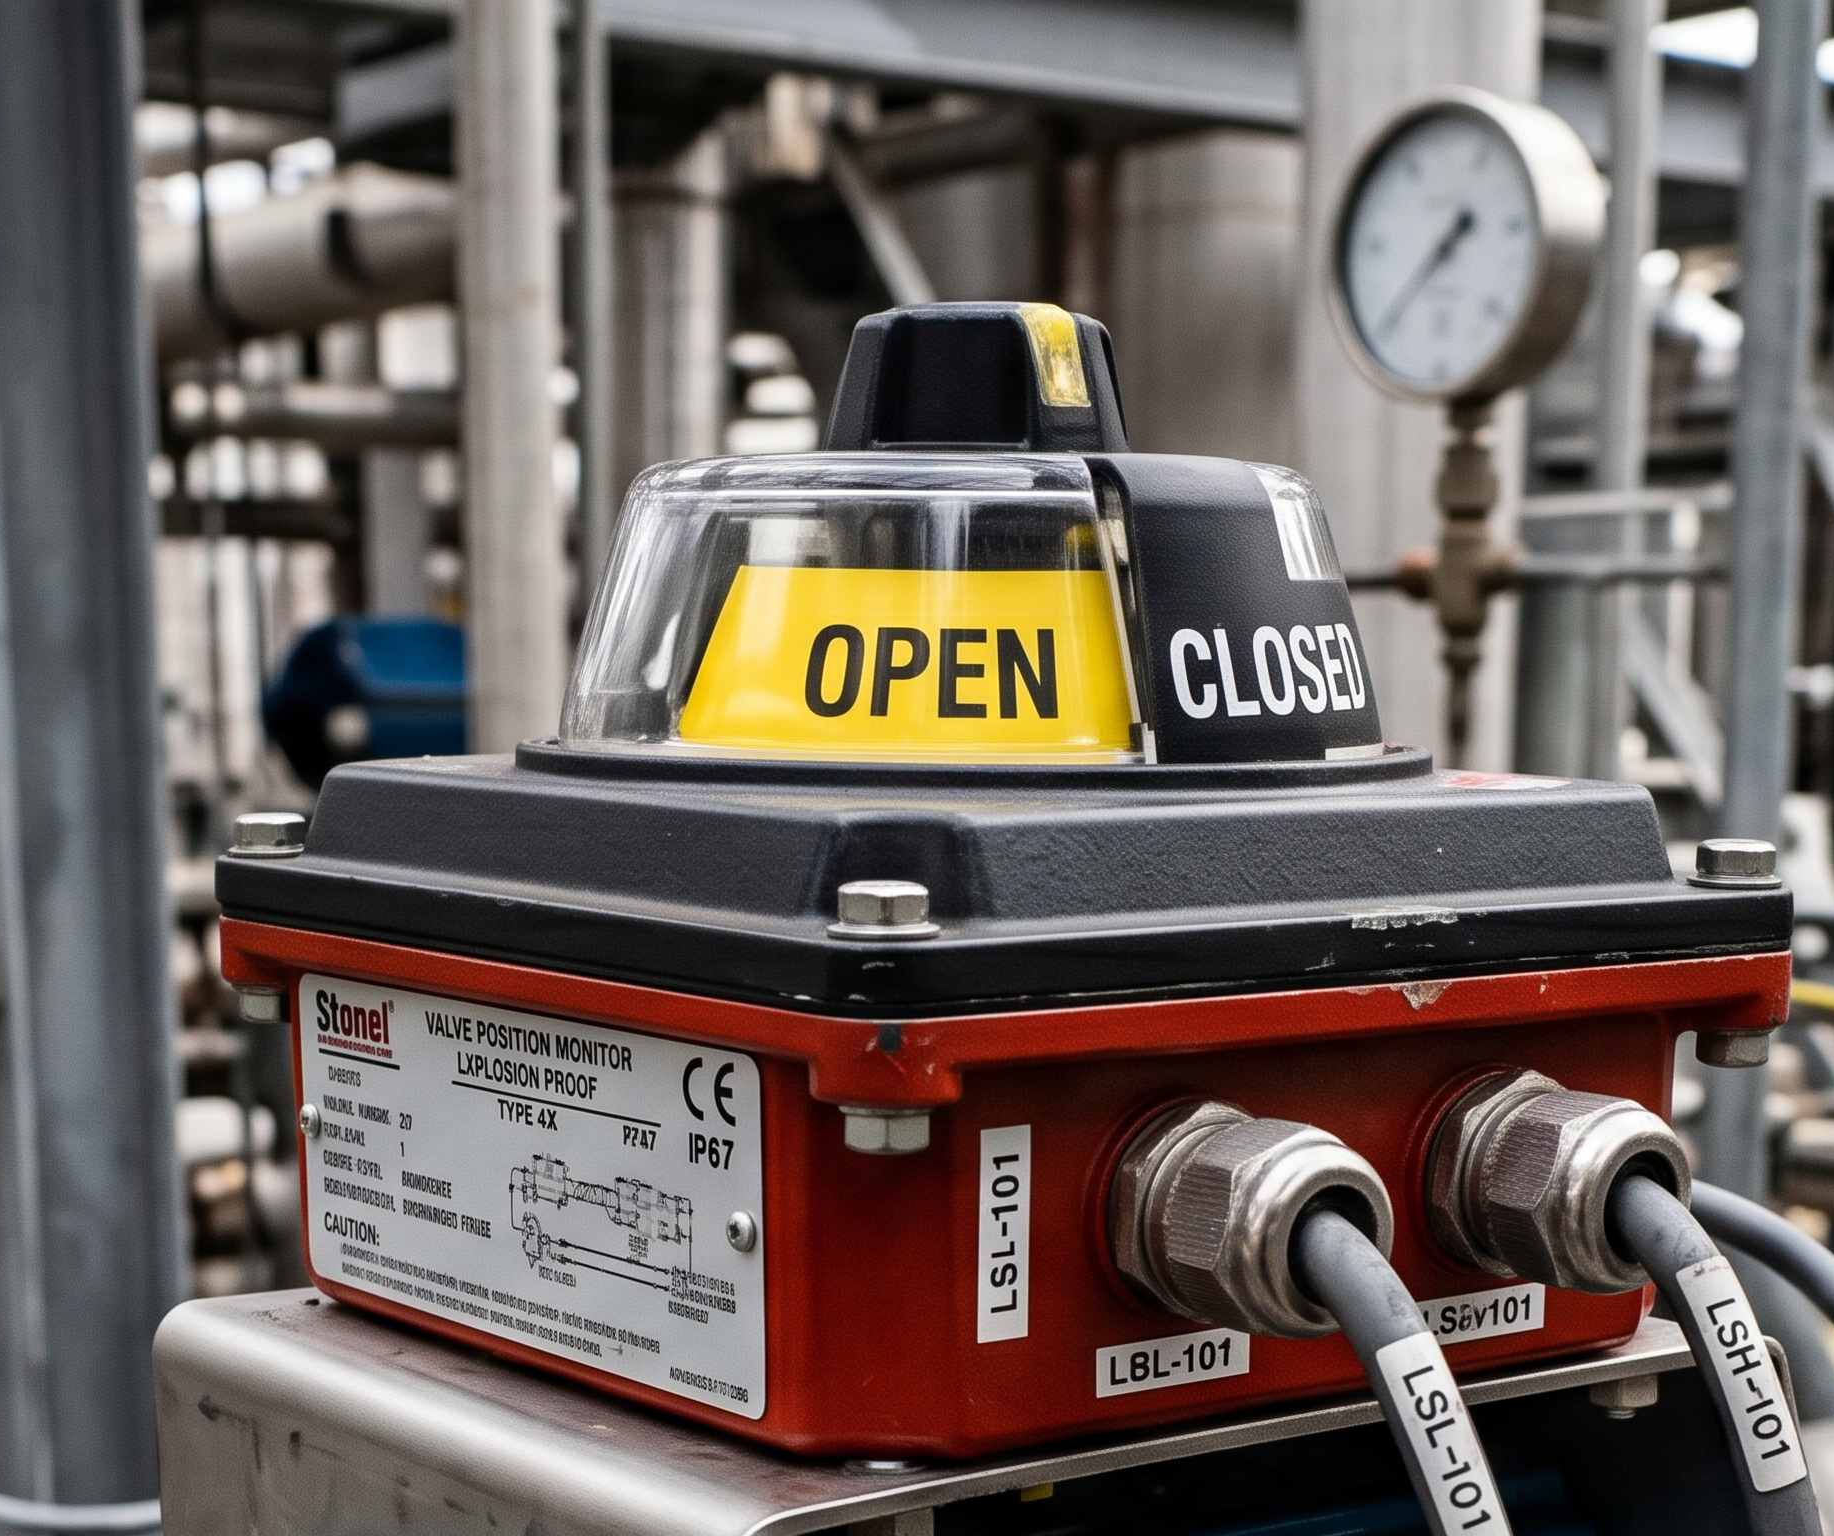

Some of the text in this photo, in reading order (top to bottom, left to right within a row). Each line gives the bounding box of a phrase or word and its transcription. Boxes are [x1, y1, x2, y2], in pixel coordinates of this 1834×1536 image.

[803, 623, 1059, 720] OPEN
[1169, 622, 1368, 720] CLOSED
[316, 989, 390, 1045] Stonel
[425, 1011, 633, 1072] VALVE POSITION MONITOR
[544, 1071, 598, 1100] PROOF
[497, 1098, 558, 1132] TYPE 4X
[689, 1132, 734, 1170] IP67
[324, 1211, 380, 1247] CAUTION:
[990, 1153, 1019, 1314] LSL-101
[1109, 1337, 1232, 1386] LBL-101
[1706, 1298, 1791, 1460] LSH-101
[1402, 1365, 1491, 1531] LSL-101
